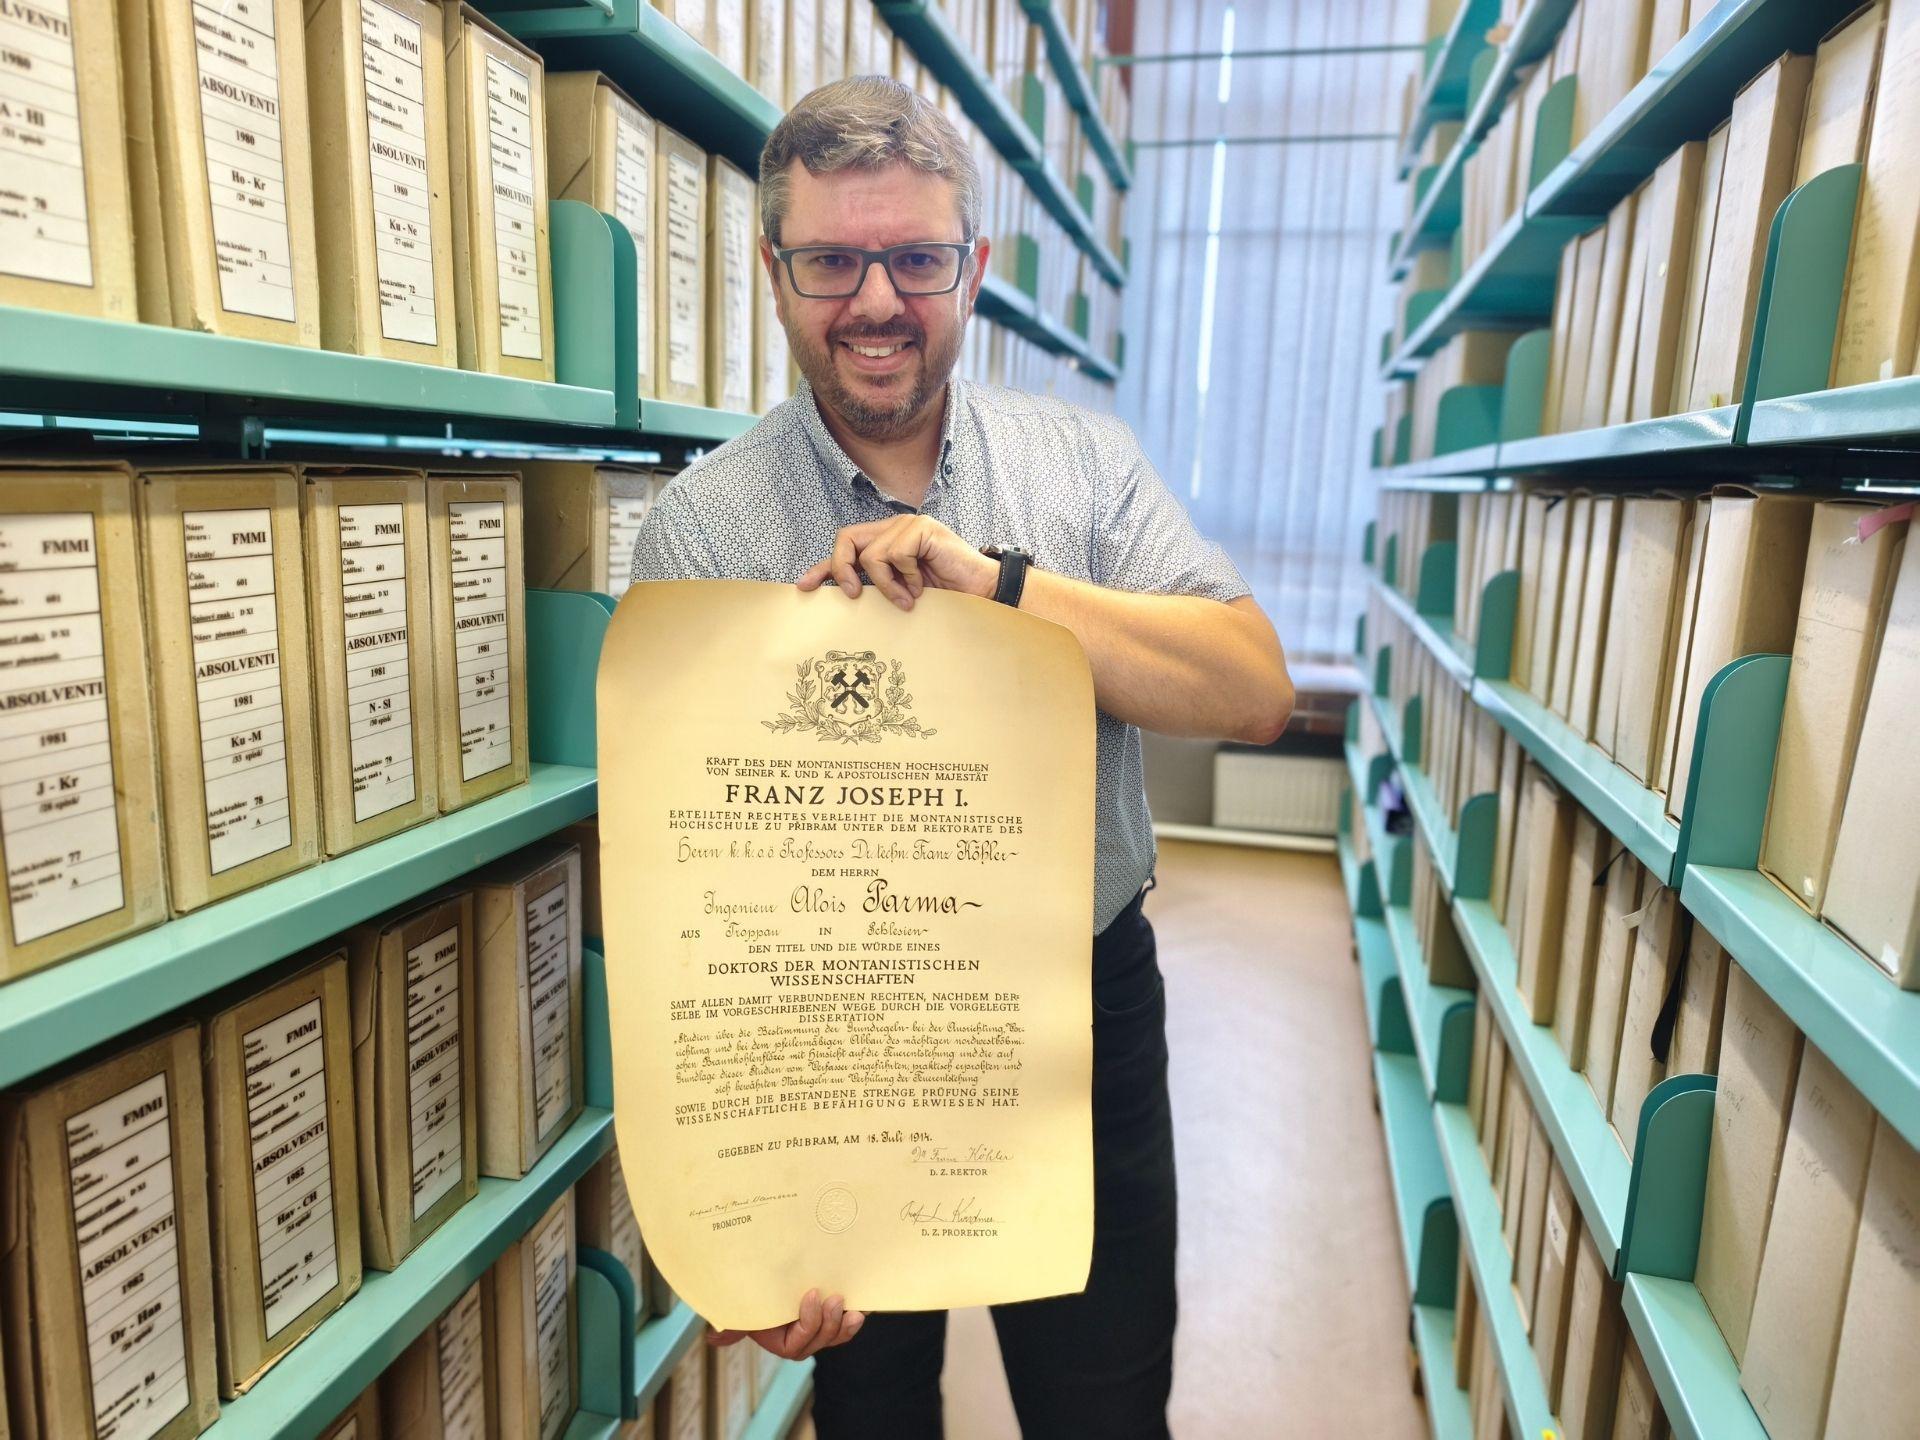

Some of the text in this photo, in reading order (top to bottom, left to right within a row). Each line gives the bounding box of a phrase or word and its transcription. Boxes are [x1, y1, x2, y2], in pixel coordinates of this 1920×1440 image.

[394, 34, 418, 55] FMMI
[201, 76, 275, 115] ABSOLVENTI
[510, 87, 526, 105] FMMI
[236, 130, 255, 145] 1980
[371, 142, 425, 170] ABSOLVENTI
[232, 170, 266, 190] Ho Kr
[394, 184, 408, 196] 1980
[494, 184, 532, 206] ABSOLVENTI
[390, 219, 417, 236] Ku Ne
[259, 250, 267, 260] 71
[409, 285, 415, 294] 72
[375, 524, 400, 535] FMMI
[479, 519, 500, 528] FMMI
[232, 532, 266, 544] FMMI
[42, 540, 89, 554] FMMI
[456, 614, 504, 629] ABSOLVENTI
[348, 629, 406, 650] ABSOLVENTI
[478, 644, 489, 654] 1981
[197, 653, 275, 678] ABSOLVENTI
[371, 667, 385, 677] 1981
[234, 695, 253, 707] 1981
[369, 703, 376, 713] N
[40, 732, 67, 746] 1981
[231, 735, 245, 748] Ku
[385, 756, 392, 764] 79
[707, 757, 988, 771] KRAFT DES DEN MONTANISTISCHEN HOCHSCHULEN
[707, 768, 988, 782] VON SEINER K. UND K. APOSTOLISCHEN MAJESTÄT
[37, 776, 79, 795] J Kr
[254, 796, 263, 805] 78
[726, 785, 968, 807] FRANZ JOSEPH I.
[670, 810, 1022, 824] ERTEILTEN RECHTES VERLEIHT DIE MONTANISTISCHE
[670, 819, 1022, 834] HOCHSCHULE ZU PŘIBRAM UNTER DEM REKTORATE DES
[68, 851, 81, 863] 77
[678, 836, 721, 862] Herrn
[780, 837, 844, 863] Professors
[812, 868, 878, 877] DEM HERRN
[704, 878, 961, 922] Ingenieur Alois Parma
[681, 930, 701, 938] AUS
[725, 922, 781, 942] Troppau
[819, 927, 832, 935] IN
[435, 943, 456, 962] FMMI
[749, 941, 940, 953] DEN TITEL UND DIE WÜRDE EINES
[708, 959, 979, 975] DOKTORS DER MONTANISTISCHEN
[770, 973, 915, 987] WISSENSCHAFTEN
[671, 1000, 696, 1010] SAMT
[701, 997, 733, 1008] ALLEN
[739, 995, 772, 1005] DAMIT
[779, 993, 865, 1004] VERBUNDENEN
[871, 992, 926, 1002] RECHTEN,
[933, 992, 988, 1001] NACHDEM
[671, 1002, 1019, 1020] SELBE IM VORGESCHRIEBENEN WEGE DURCH DIE VORGELEGTE
[800, 1013, 884, 1023] DISSERTATION
[287, 1019, 317, 1044] FMMI
[411, 1033, 458, 1074] ABSOLVENTI
[676, 1087, 1019, 1115] SOWIE DURCH DIE BESTANDENE STRENGE PRÜFUNG SEINE
[122, 1097, 163, 1127] FMMI
[676, 1098, 1018, 1126] WISSENSCHAFTLICHE BEFÄHIGUNG ERWIESEN HAT.
[255, 1122, 324, 1173] ABSOLVENTI
[718, 1142, 764, 1159] GEGEBEN
[768, 1140, 782, 1150] ZU
[786, 1135, 839, 1148] PŘIBRAM,
[843, 1134, 859, 1144] AM
[287, 1167, 305, 1186] 1982
[303, 1190, 317, 1207] CH
[713, 1215, 752, 1231] PROMOTOR
[922, 1229, 998, 1237] D. Z. PROREKTOR
[84, 1215, 174, 1282] ABSOLVENTI
[122, 1272, 144, 1295] 1982
[110, 1328, 126, 1345] Dr
